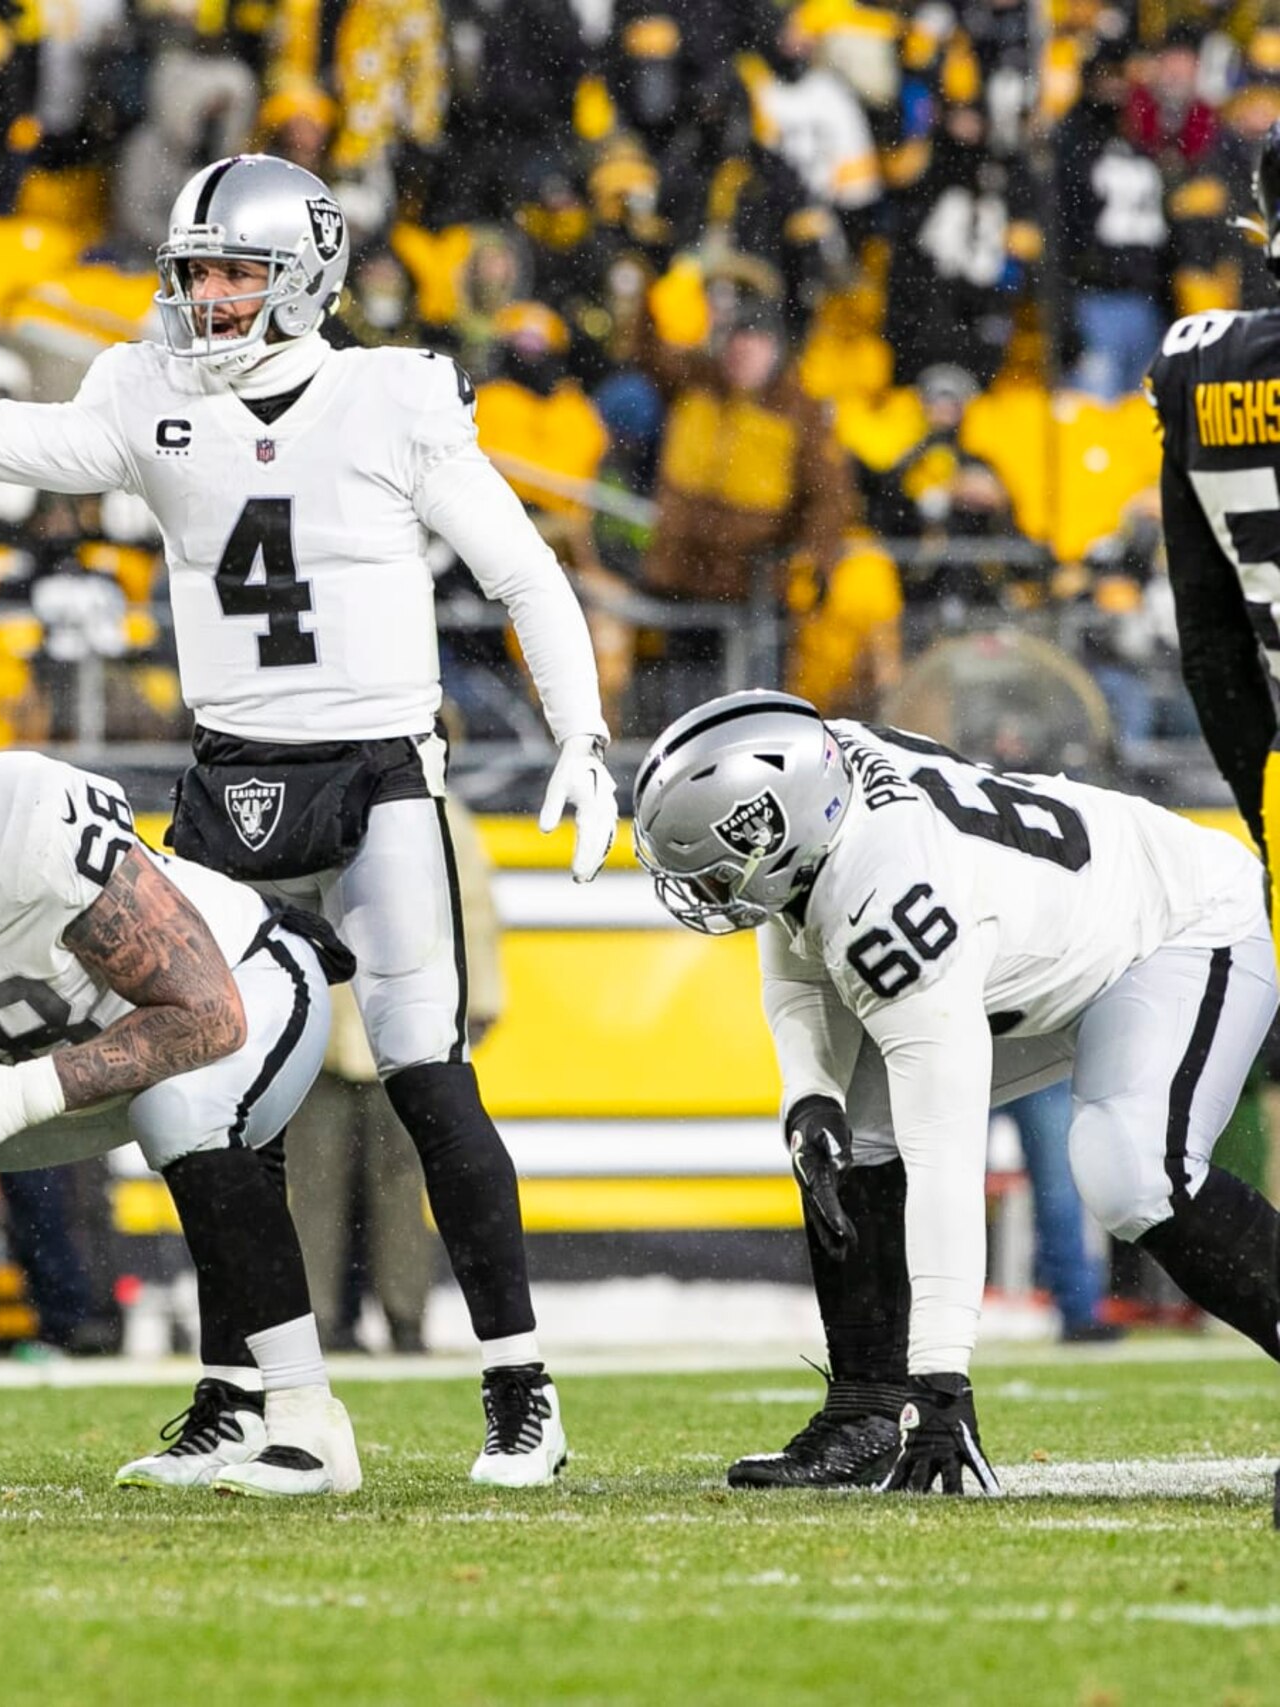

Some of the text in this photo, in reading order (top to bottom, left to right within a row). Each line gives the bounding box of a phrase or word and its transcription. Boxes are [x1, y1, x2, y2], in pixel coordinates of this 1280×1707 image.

[156, 419, 192, 448] C
[215, 497, 319, 668] 4
[231, 788, 277, 799] RAIDERS
[721, 797, 770, 833] RAIDERS
[846, 883, 959, 998] 66
